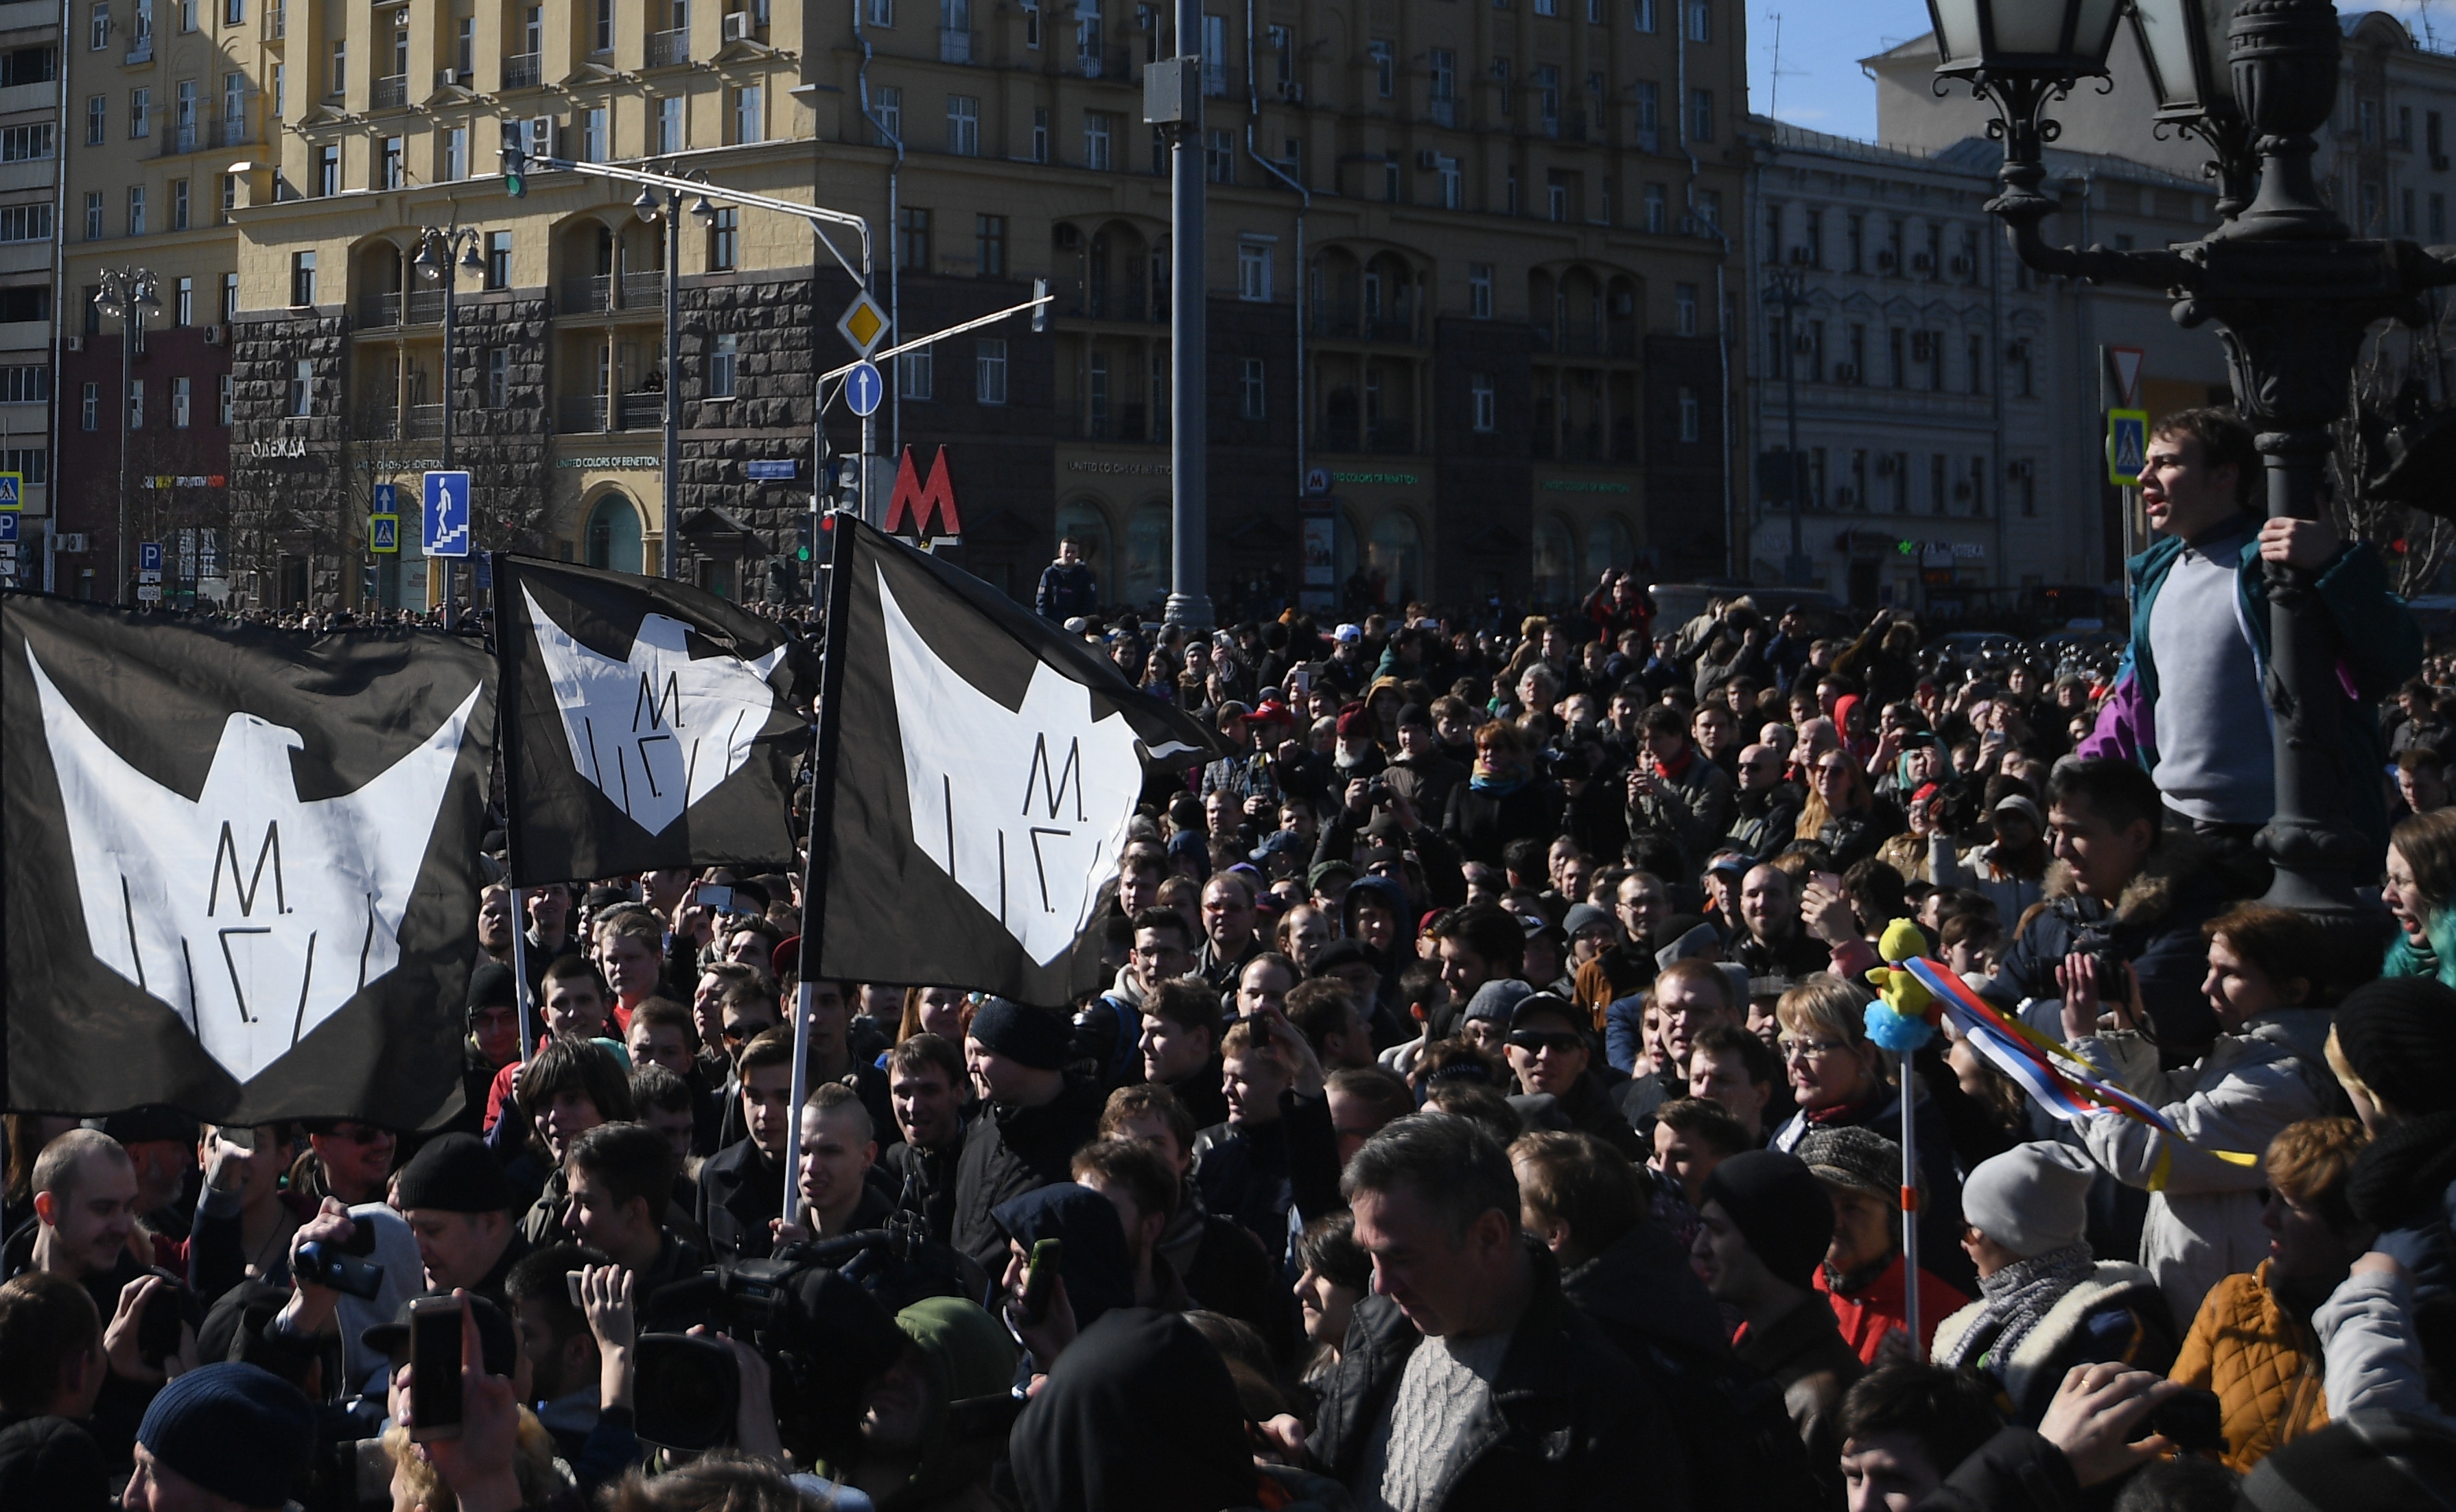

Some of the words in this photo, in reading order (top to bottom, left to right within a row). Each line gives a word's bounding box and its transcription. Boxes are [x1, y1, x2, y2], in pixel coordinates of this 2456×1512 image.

[251, 436, 306, 459] ОДЕЖДА
[557, 458, 582, 469] UNITED
[583, 457, 610, 468] COLORS
[611, 456, 622, 467] OF
